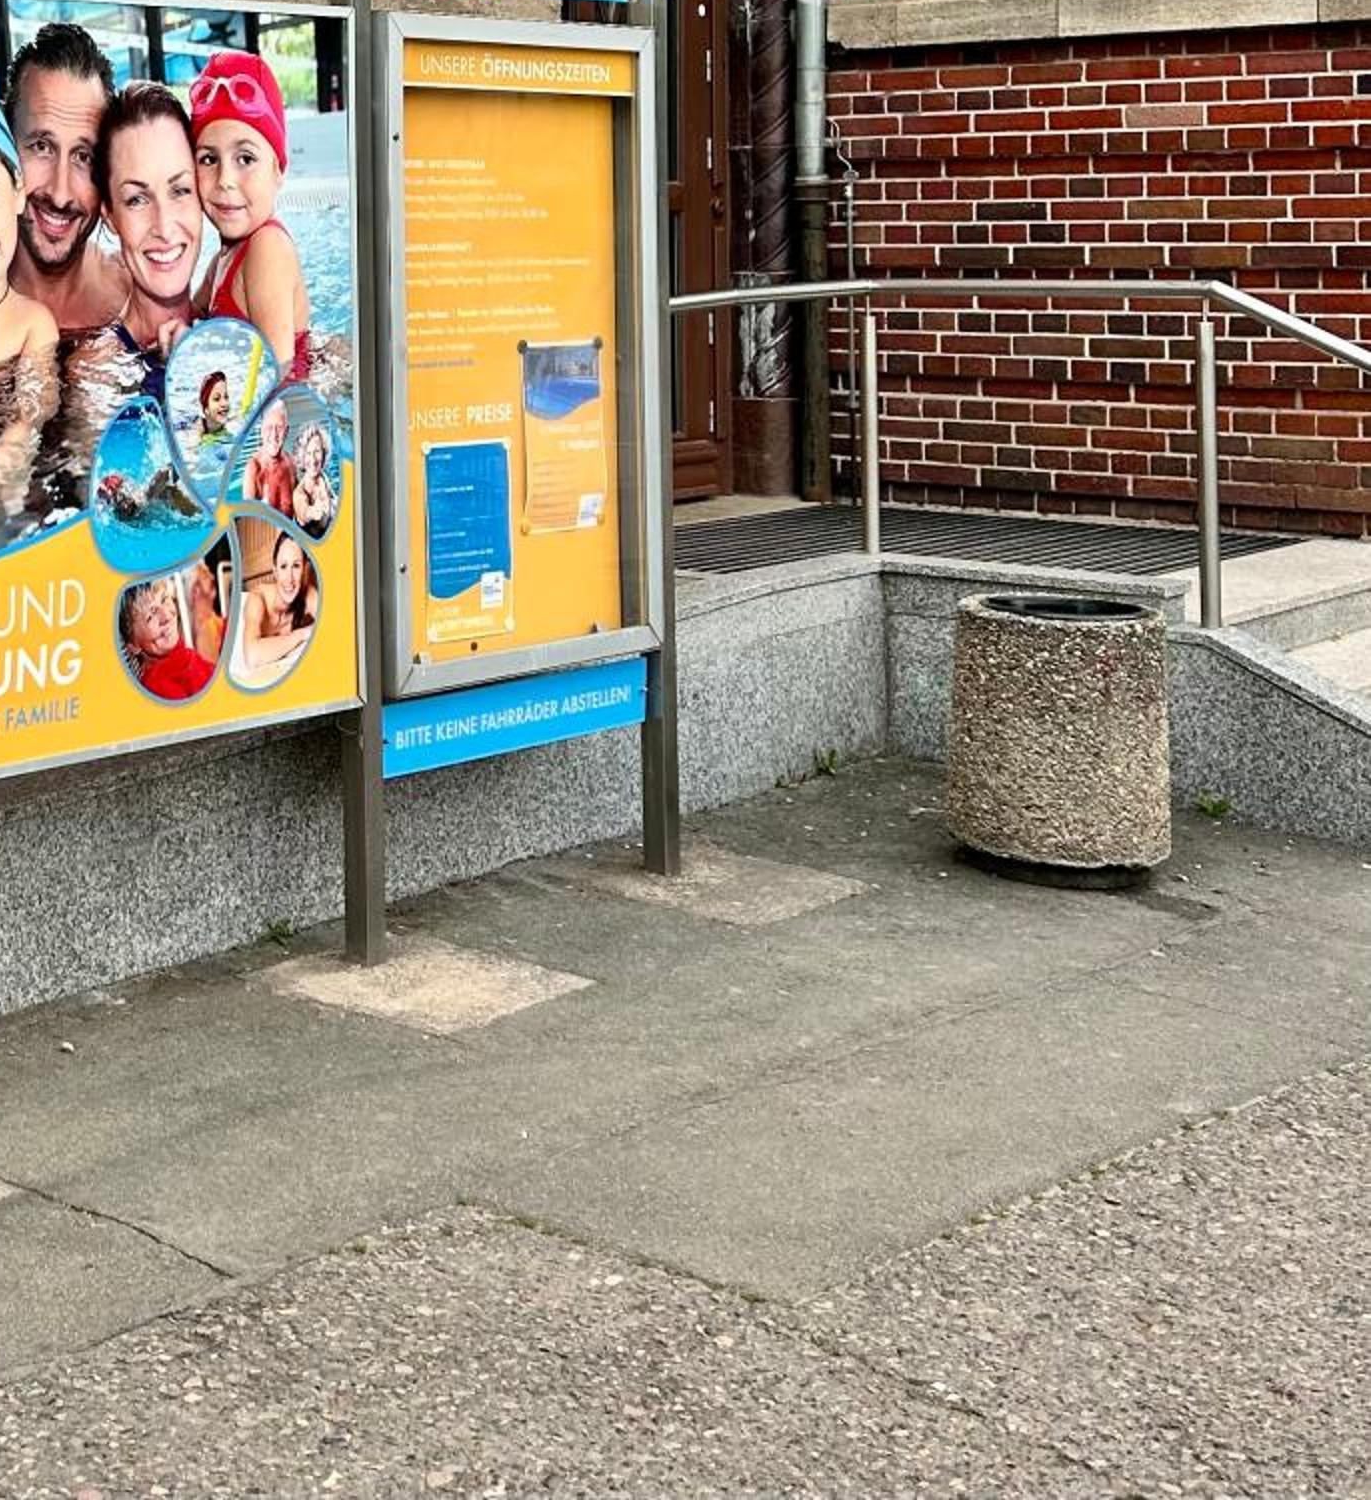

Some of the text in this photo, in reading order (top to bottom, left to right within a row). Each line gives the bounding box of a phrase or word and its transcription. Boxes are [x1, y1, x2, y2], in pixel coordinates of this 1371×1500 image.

[420, 54, 612, 84] UNSERE ÖFFNUNGSZEITEN
[465, 403, 513, 426] PREISE
[5, 696, 80, 731] FAMILIE
[395, 684, 632, 751] BITTE KEINE FAHRRÄDER ABSTELLEN!
